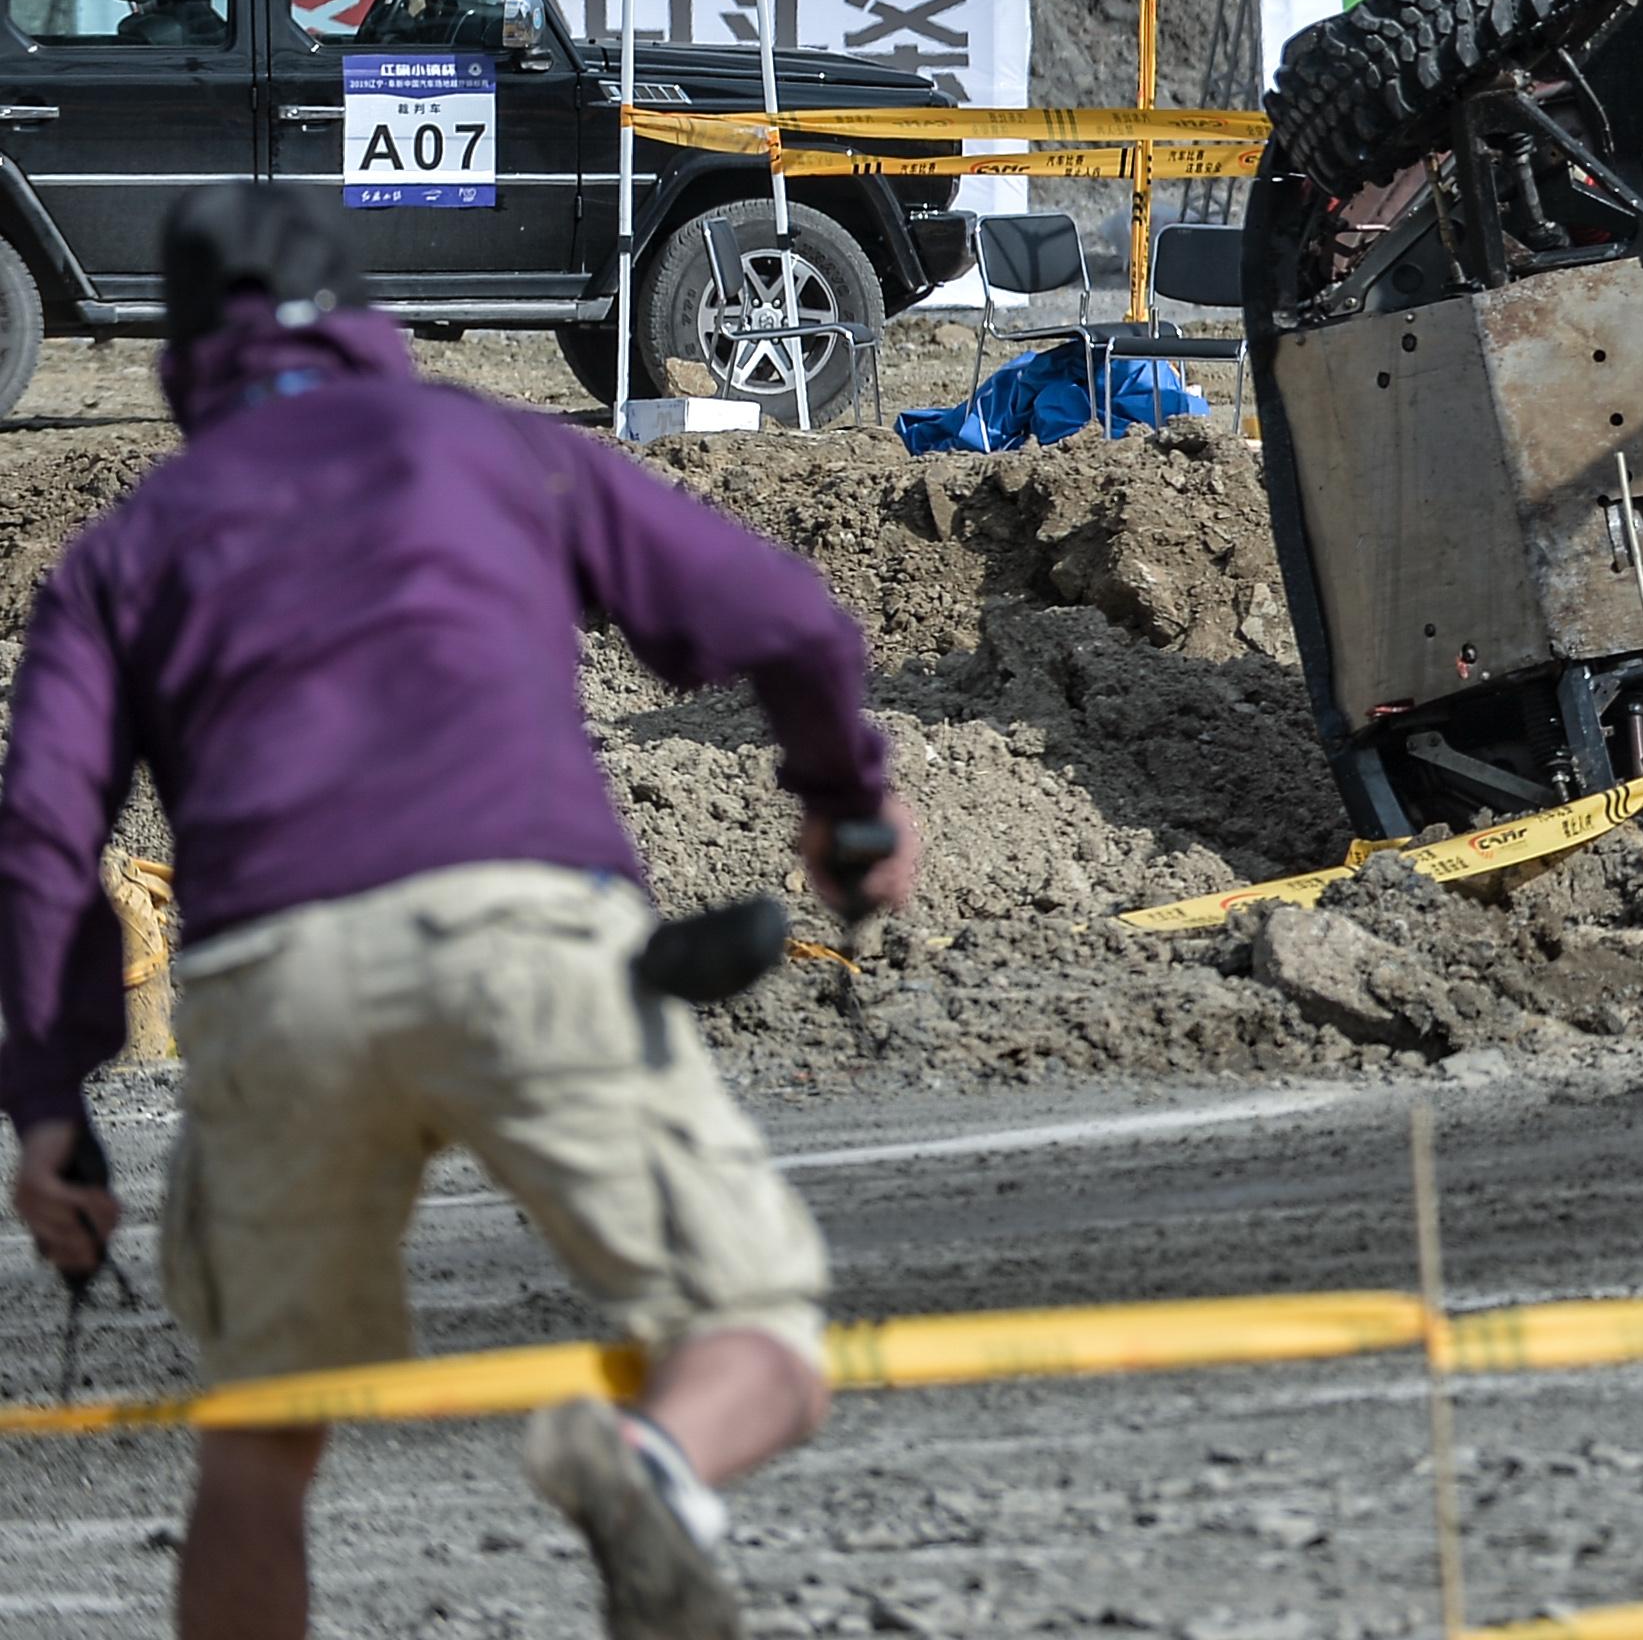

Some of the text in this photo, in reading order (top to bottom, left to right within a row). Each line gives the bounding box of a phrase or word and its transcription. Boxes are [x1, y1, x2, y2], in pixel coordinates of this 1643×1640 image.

[398, 103, 442, 115] 裁判车
[359, 123, 487, 171] A07
[1046, 154, 1085, 168] 汽车比赛
[1168, 149, 1206, 162] 汽车比赛
[1185, 162, 1223, 174] 注意安全
